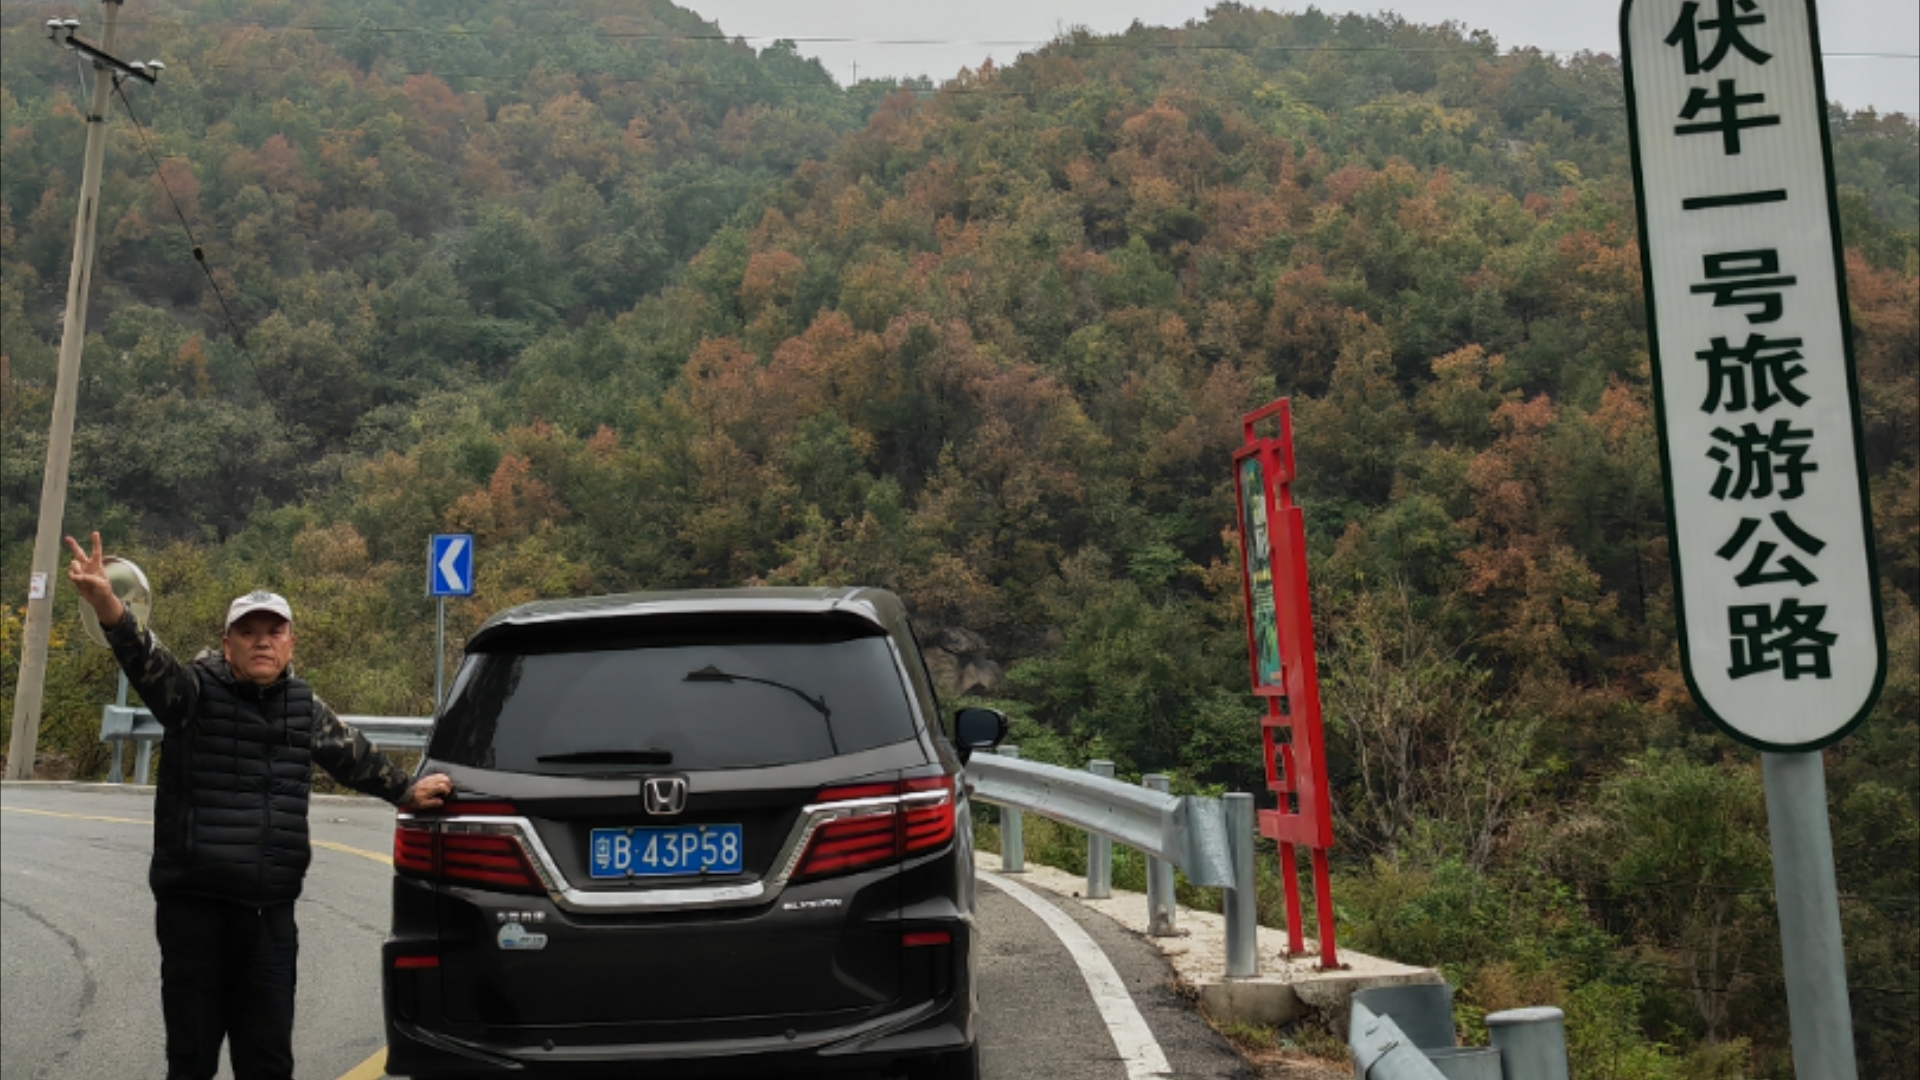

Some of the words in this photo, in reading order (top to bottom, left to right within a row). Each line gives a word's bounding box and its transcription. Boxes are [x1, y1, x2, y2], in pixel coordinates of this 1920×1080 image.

[1663, 0, 1839, 681] 伏牛一号旅游公路
